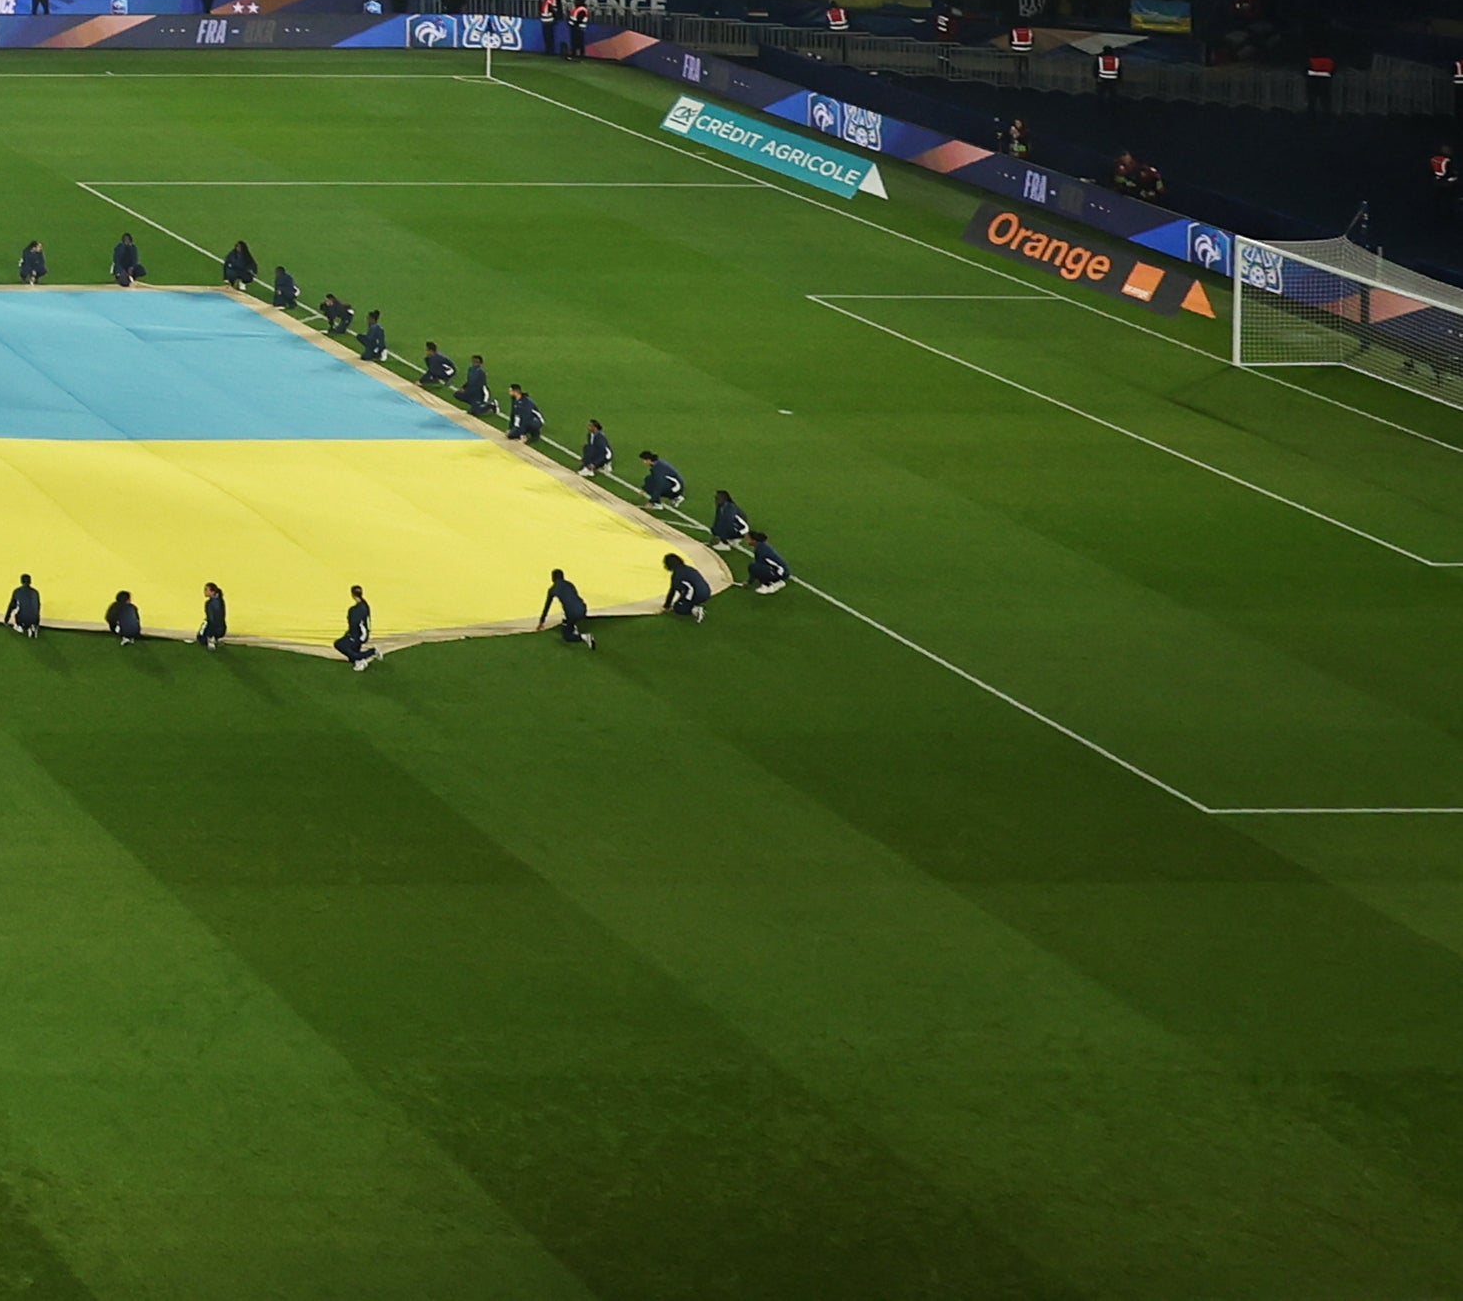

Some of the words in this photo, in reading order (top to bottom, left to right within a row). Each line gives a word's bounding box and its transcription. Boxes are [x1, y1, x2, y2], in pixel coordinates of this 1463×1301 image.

[196, 20, 227, 44] FRA
[695, 115, 763, 148] CRÉDIT
[760, 140, 861, 186] AGRICOLE
[988, 213, 1111, 281] Orange
